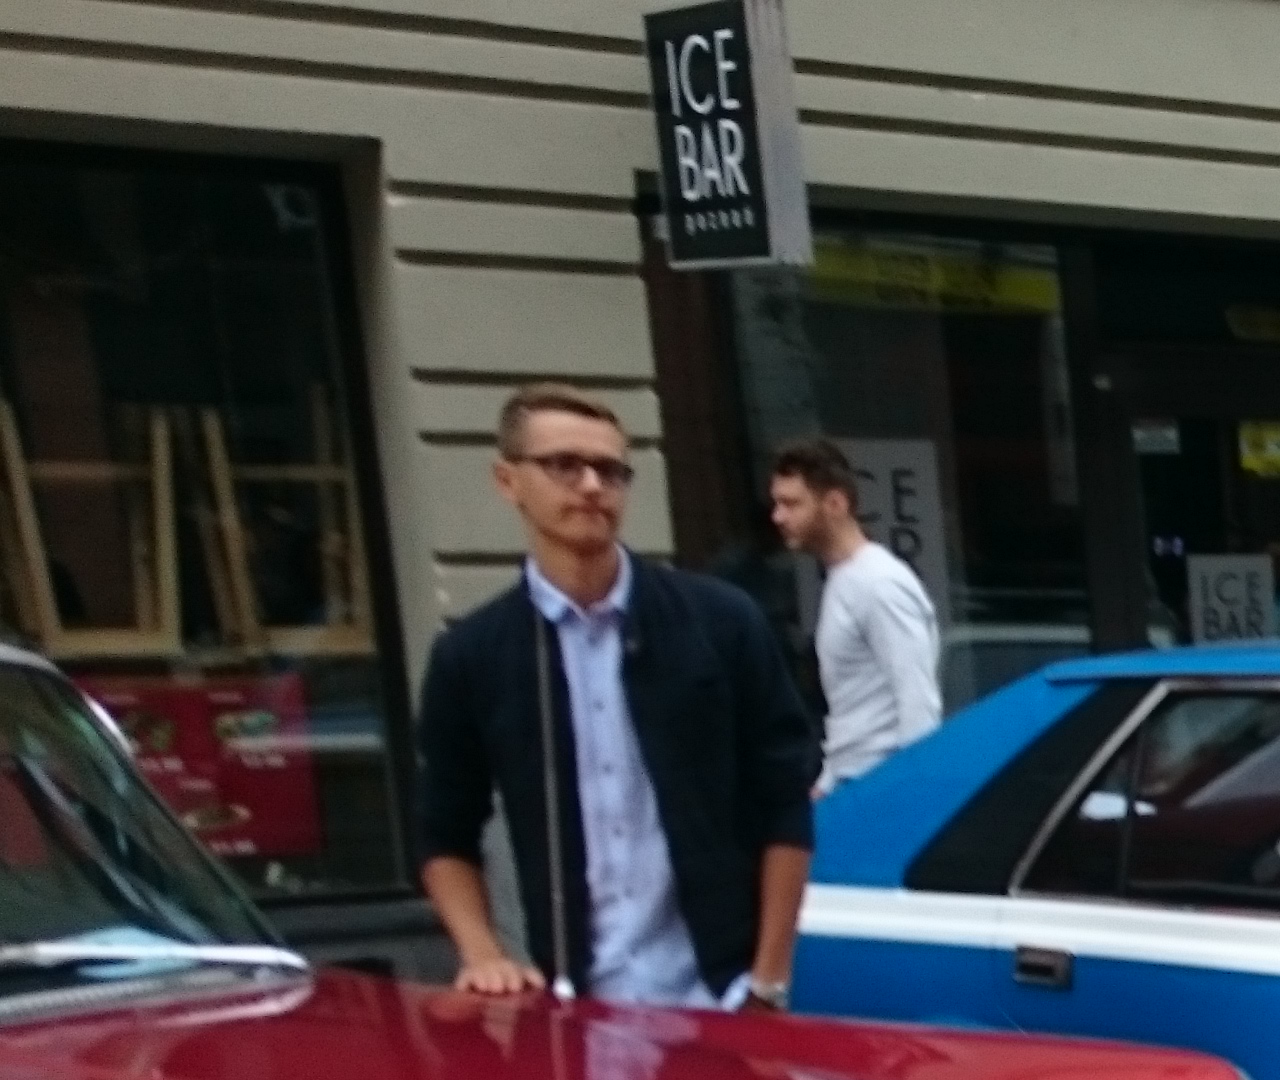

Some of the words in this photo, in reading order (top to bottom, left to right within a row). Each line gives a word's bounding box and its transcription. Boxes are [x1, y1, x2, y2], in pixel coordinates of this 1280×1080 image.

[665, 28, 742, 118] ICE
[674, 117, 750, 201] BAR
[1200, 571, 1262, 607] ICE
